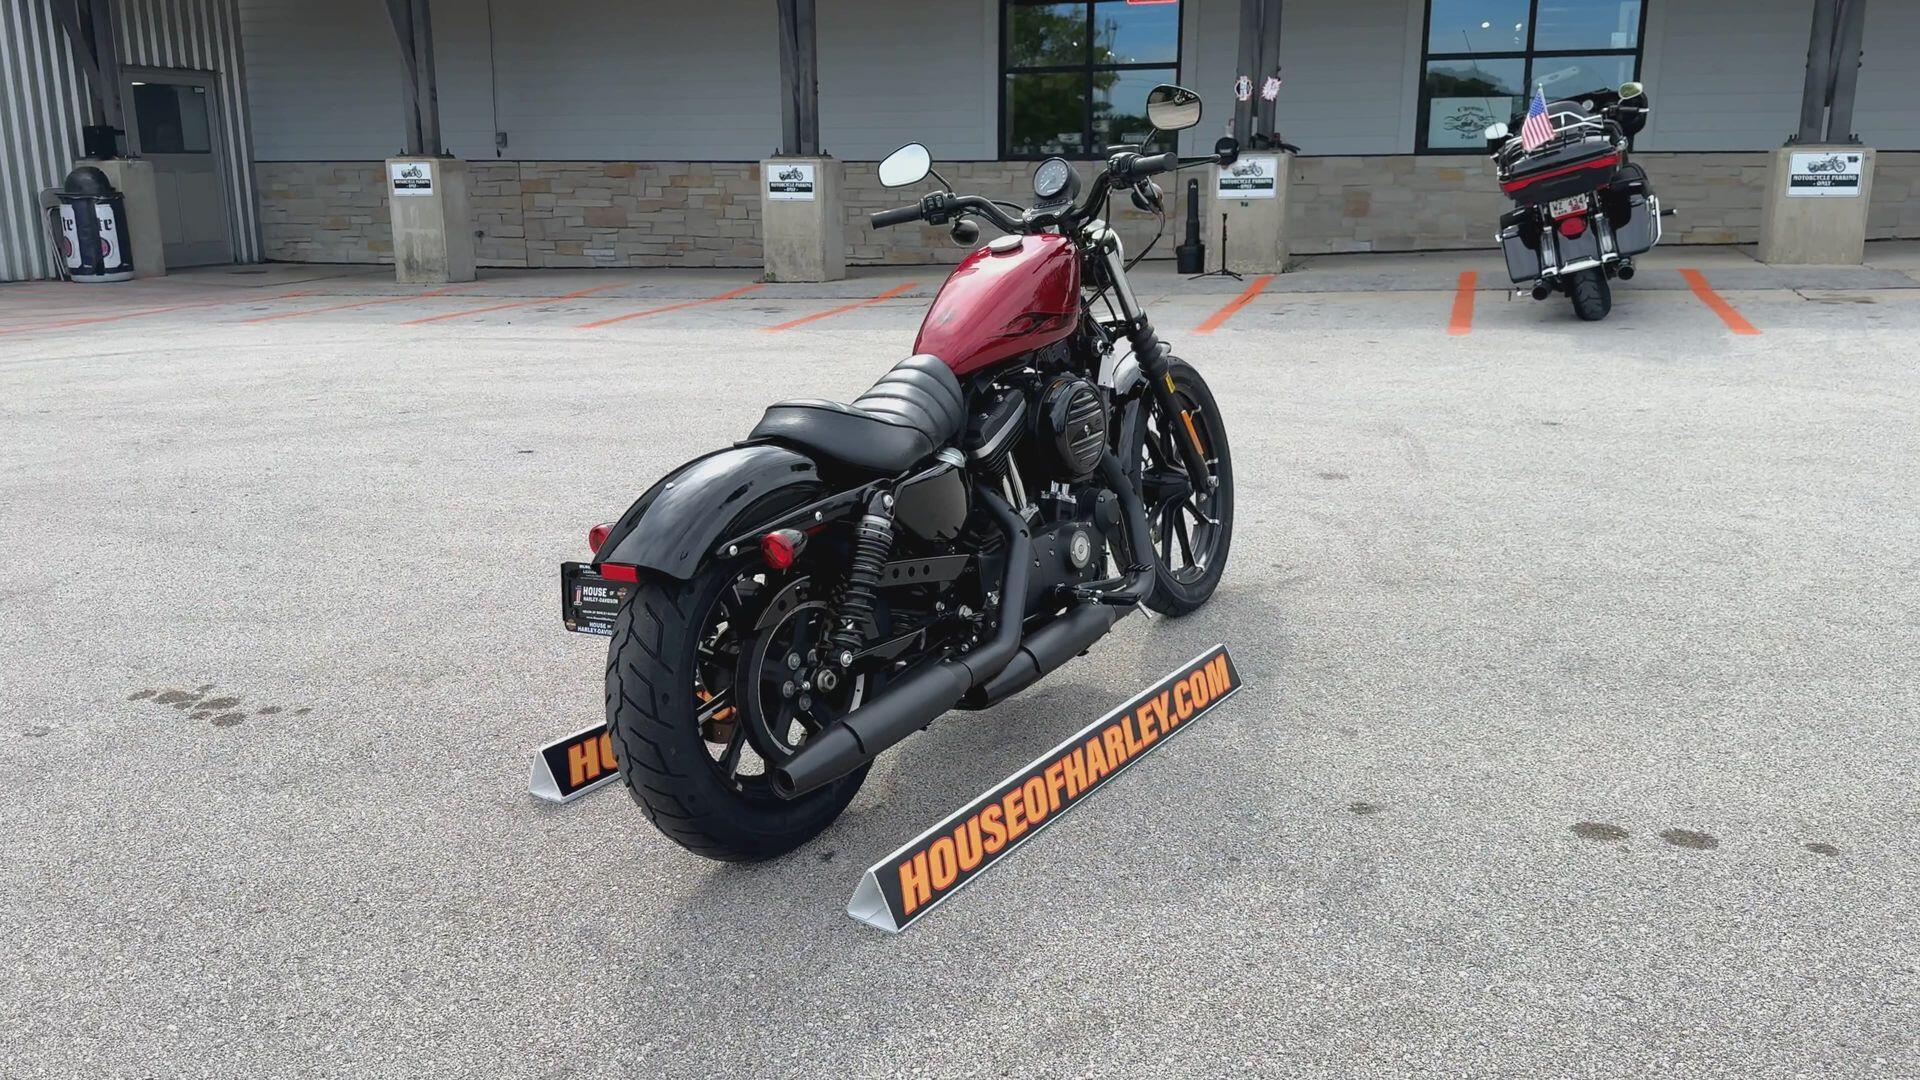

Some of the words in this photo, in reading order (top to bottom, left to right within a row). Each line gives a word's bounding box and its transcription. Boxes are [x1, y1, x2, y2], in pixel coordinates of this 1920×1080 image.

[583, 586, 607, 597] HOUSE
[588, 621, 607, 629] HOUSE
[898, 652, 1231, 916] HOUSEOFHARLEY.COM
